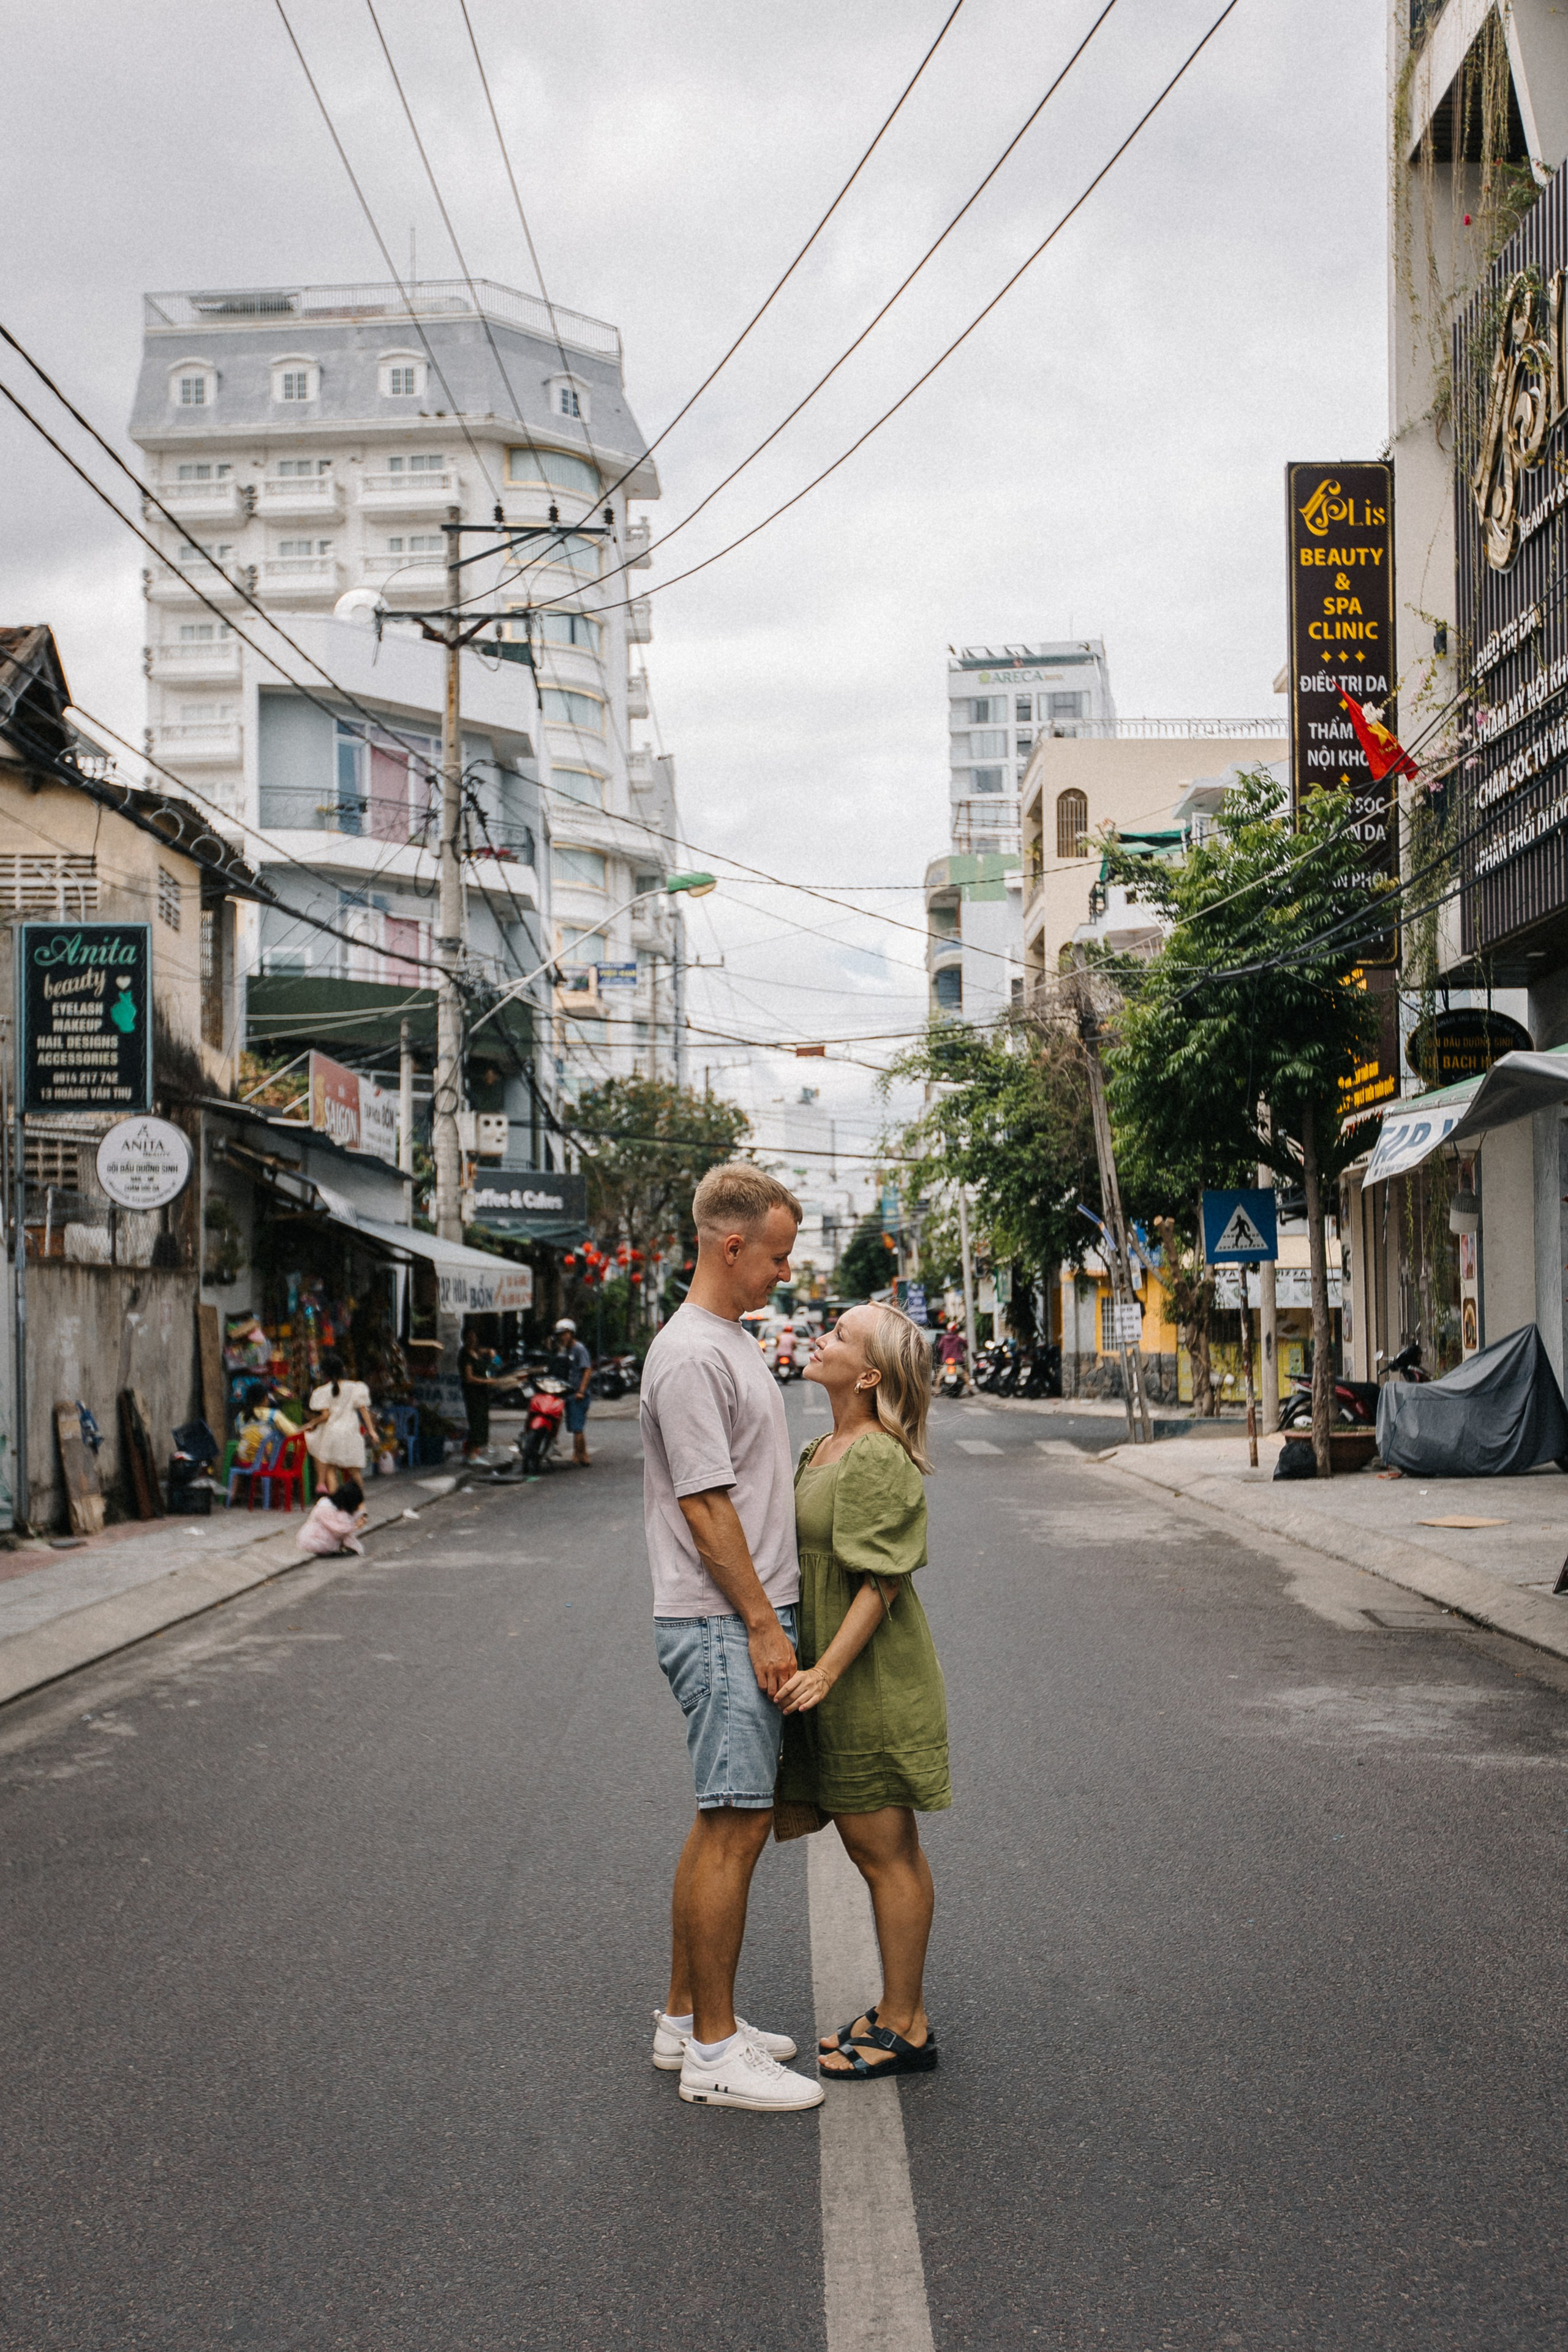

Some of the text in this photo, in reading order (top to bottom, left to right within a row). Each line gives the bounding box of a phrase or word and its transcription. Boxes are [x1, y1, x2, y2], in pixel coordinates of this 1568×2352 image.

[1519, 488, 1556, 543] BEAUTY
[1300, 548, 1384, 566] BEAUTY
[1334, 572, 1351, 590] &
[1323, 597, 1363, 615] SPA
[1308, 621, 1379, 640] CLINIC
[994, 670, 1044, 682] ARECA
[1300, 669, 1388, 697] ĐIỀU TRỊ DA
[1308, 715, 1353, 739] THẨM
[1308, 745, 1335, 771] NỘI
[1510, 748, 1532, 788] SÓC
[34, 932, 137, 966] Anita
[43, 967, 105, 1000] beauty
[51, 1001, 104, 1016] EYELASH
[53, 1018, 103, 1033] MAKEUP
[37, 1035, 119, 1049] NAIL DESIGNS
[37, 1051, 119, 1066] ACCESSORIES
[121, 1139, 165, 1152] ANITA
